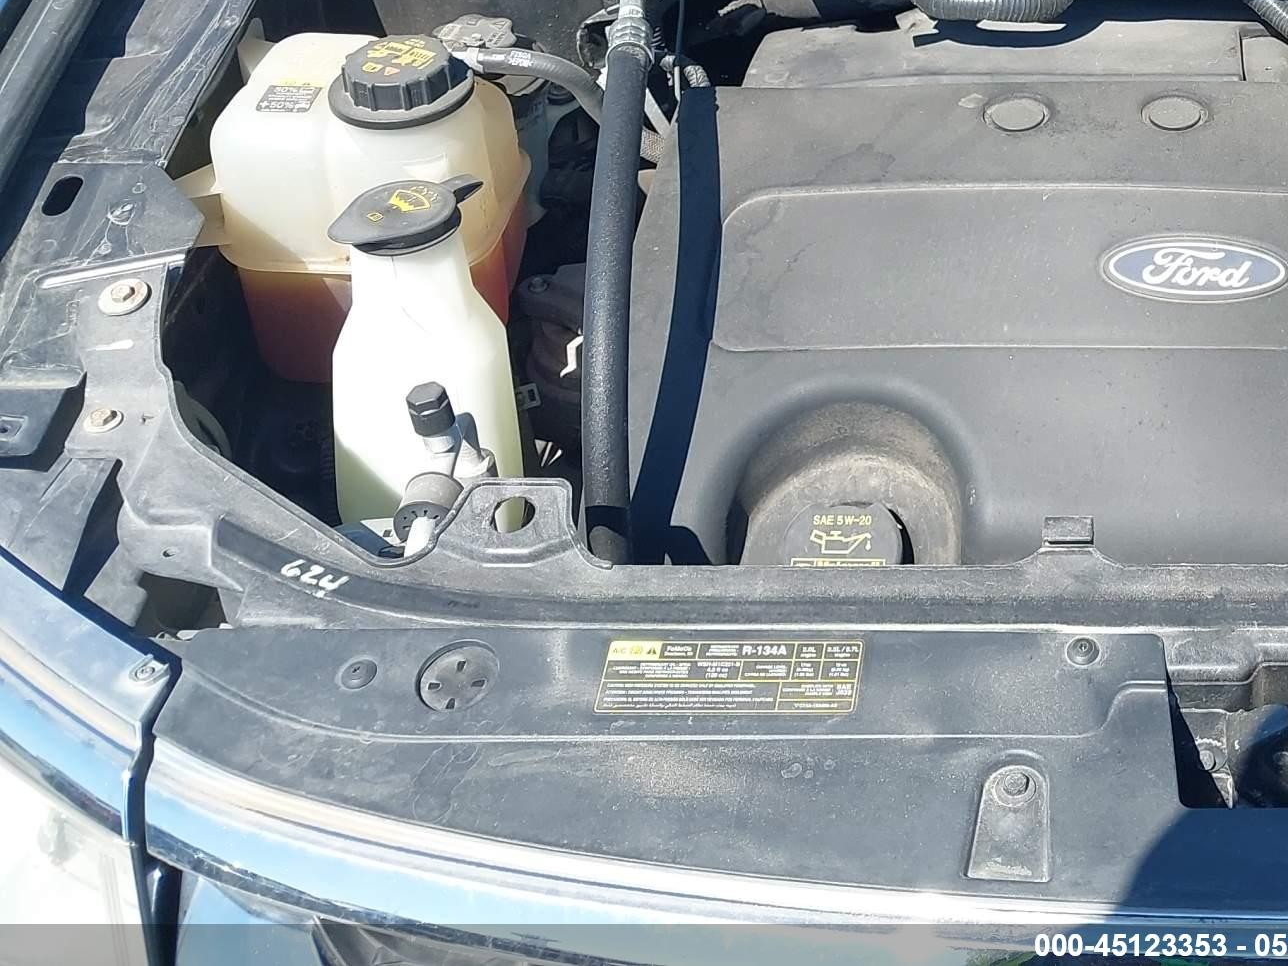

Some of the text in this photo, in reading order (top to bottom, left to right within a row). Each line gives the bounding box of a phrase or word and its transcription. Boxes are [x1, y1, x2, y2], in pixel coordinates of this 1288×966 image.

[1142, 247, 1253, 288] Ford
[813, 515, 835, 526] SAE
[742, 645, 787, 656] R-134A
